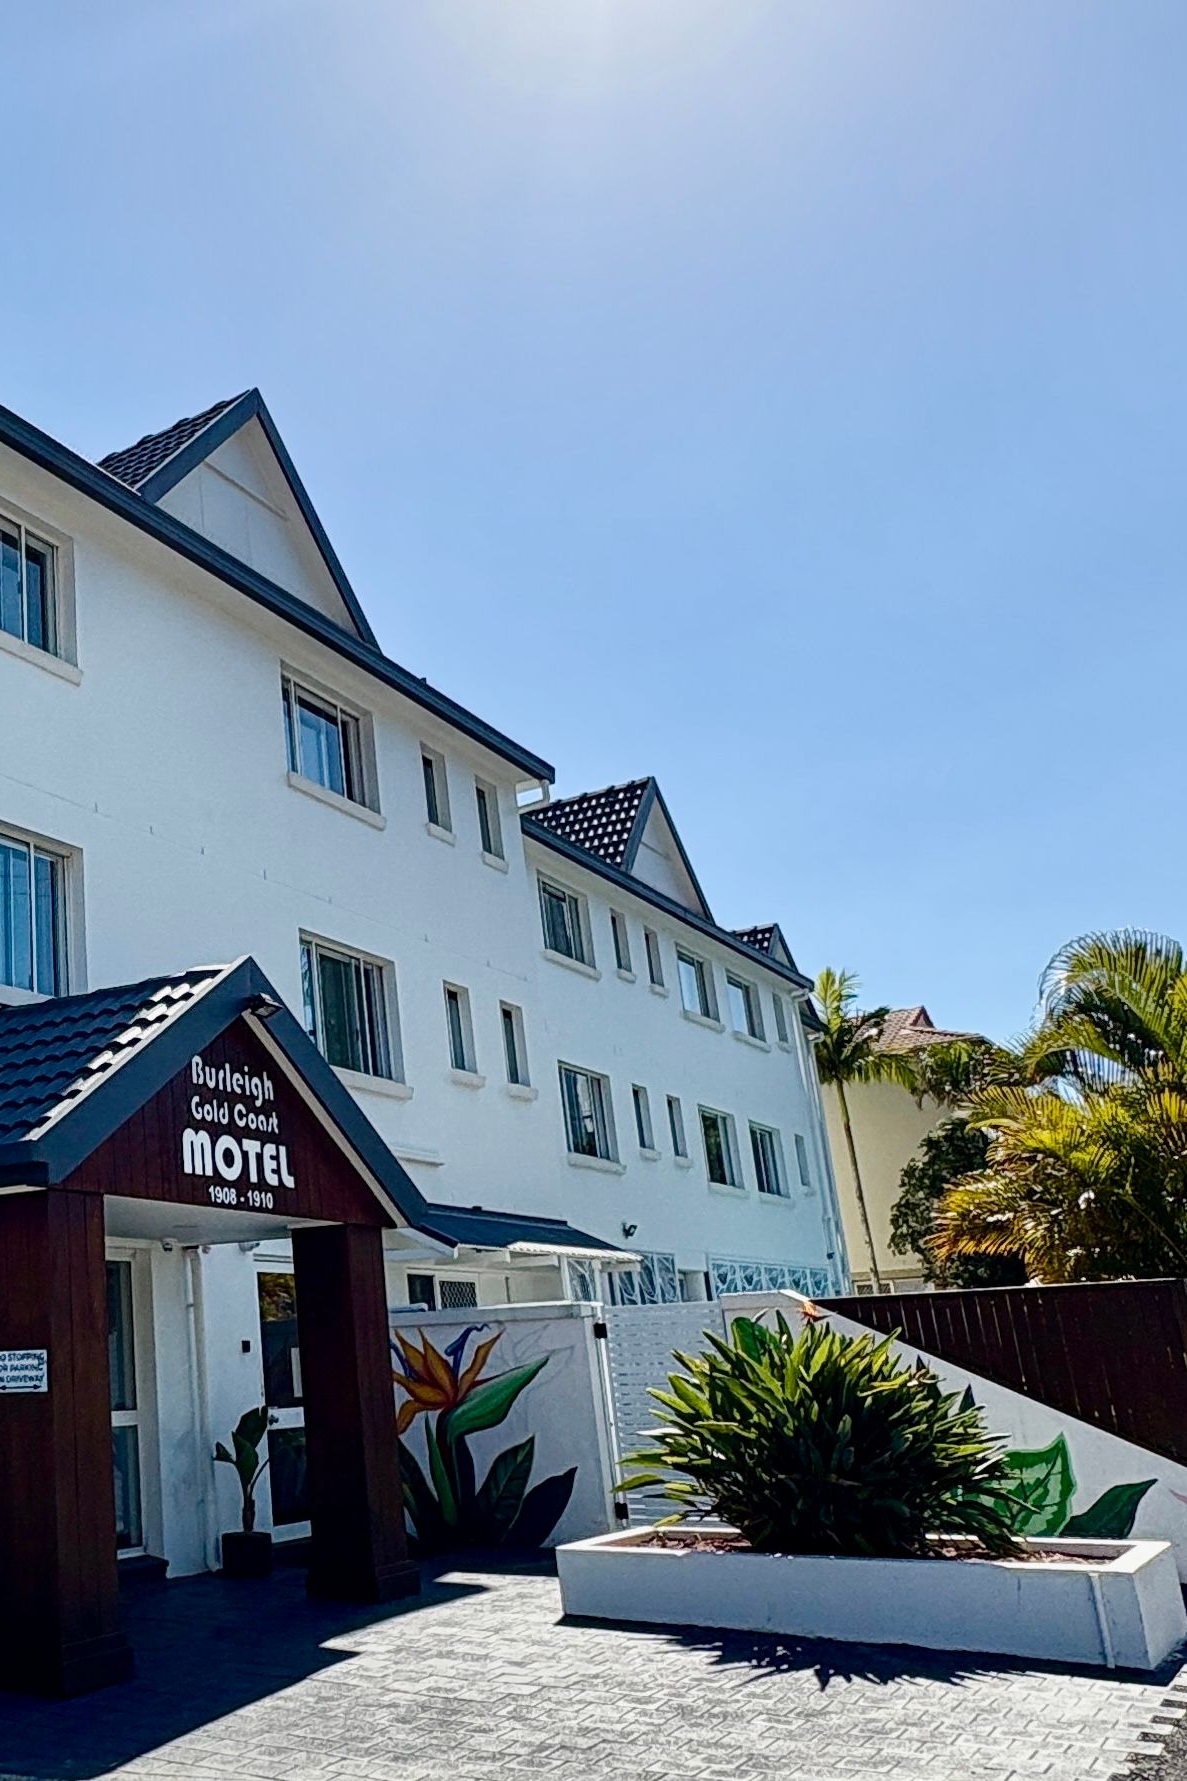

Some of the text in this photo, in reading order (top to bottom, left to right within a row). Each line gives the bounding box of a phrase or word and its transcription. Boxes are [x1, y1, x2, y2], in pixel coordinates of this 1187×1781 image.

[191, 1055, 274, 1108] Burleigh
[190, 1095, 279, 1134] Gold Coast
[182, 1127, 295, 1189] MOTEL
[208, 1185, 237, 1205] 1908
[247, 1190, 274, 1209] 1910
[6, 1374, 44, 1383] DRIVEWAY
[10, 1363, 44, 1372] PARKING
